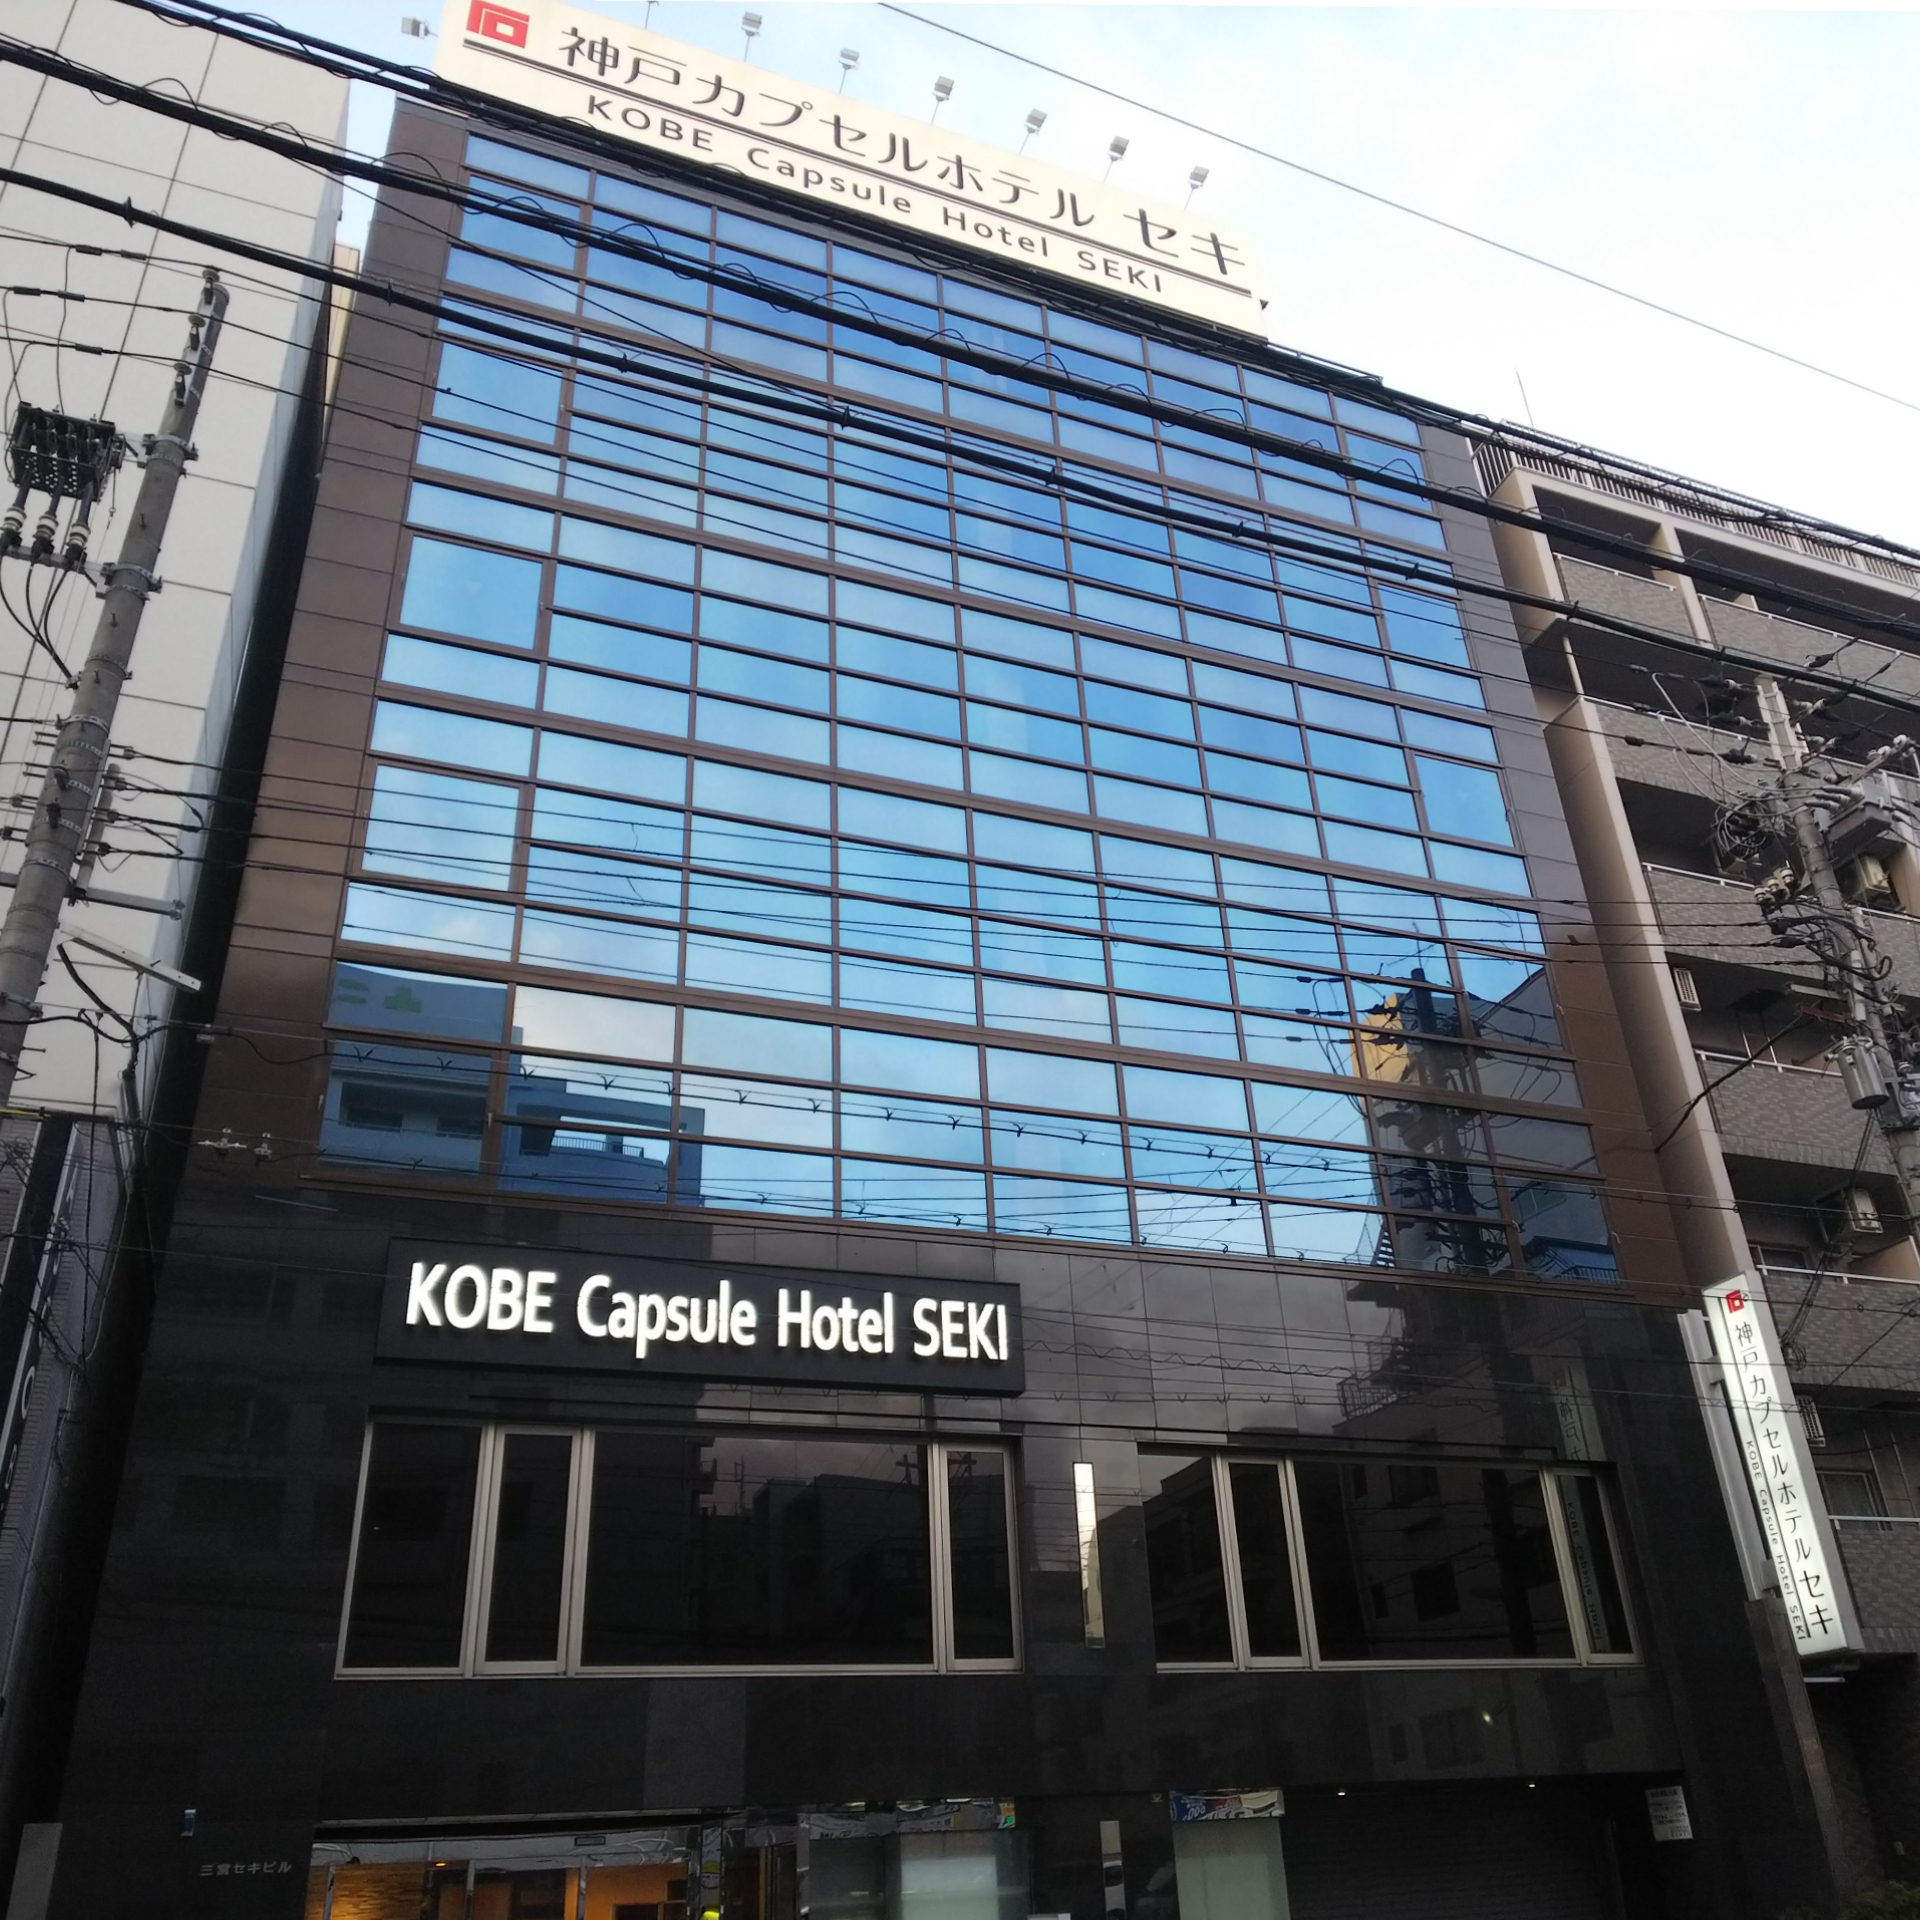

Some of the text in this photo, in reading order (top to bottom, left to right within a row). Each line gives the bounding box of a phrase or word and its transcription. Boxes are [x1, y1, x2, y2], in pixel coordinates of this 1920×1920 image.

[559, 26, 1245, 276] 神戸カプセルホテル セキ
[587, 95, 1162, 293] KOBE Capsule Hotel SEKI
[405, 1261, 1009, 1361] KOBE Capsule Hotel SEKI
[1746, 1440, 1806, 1640] KOBE Capsule Hotel SEKI
